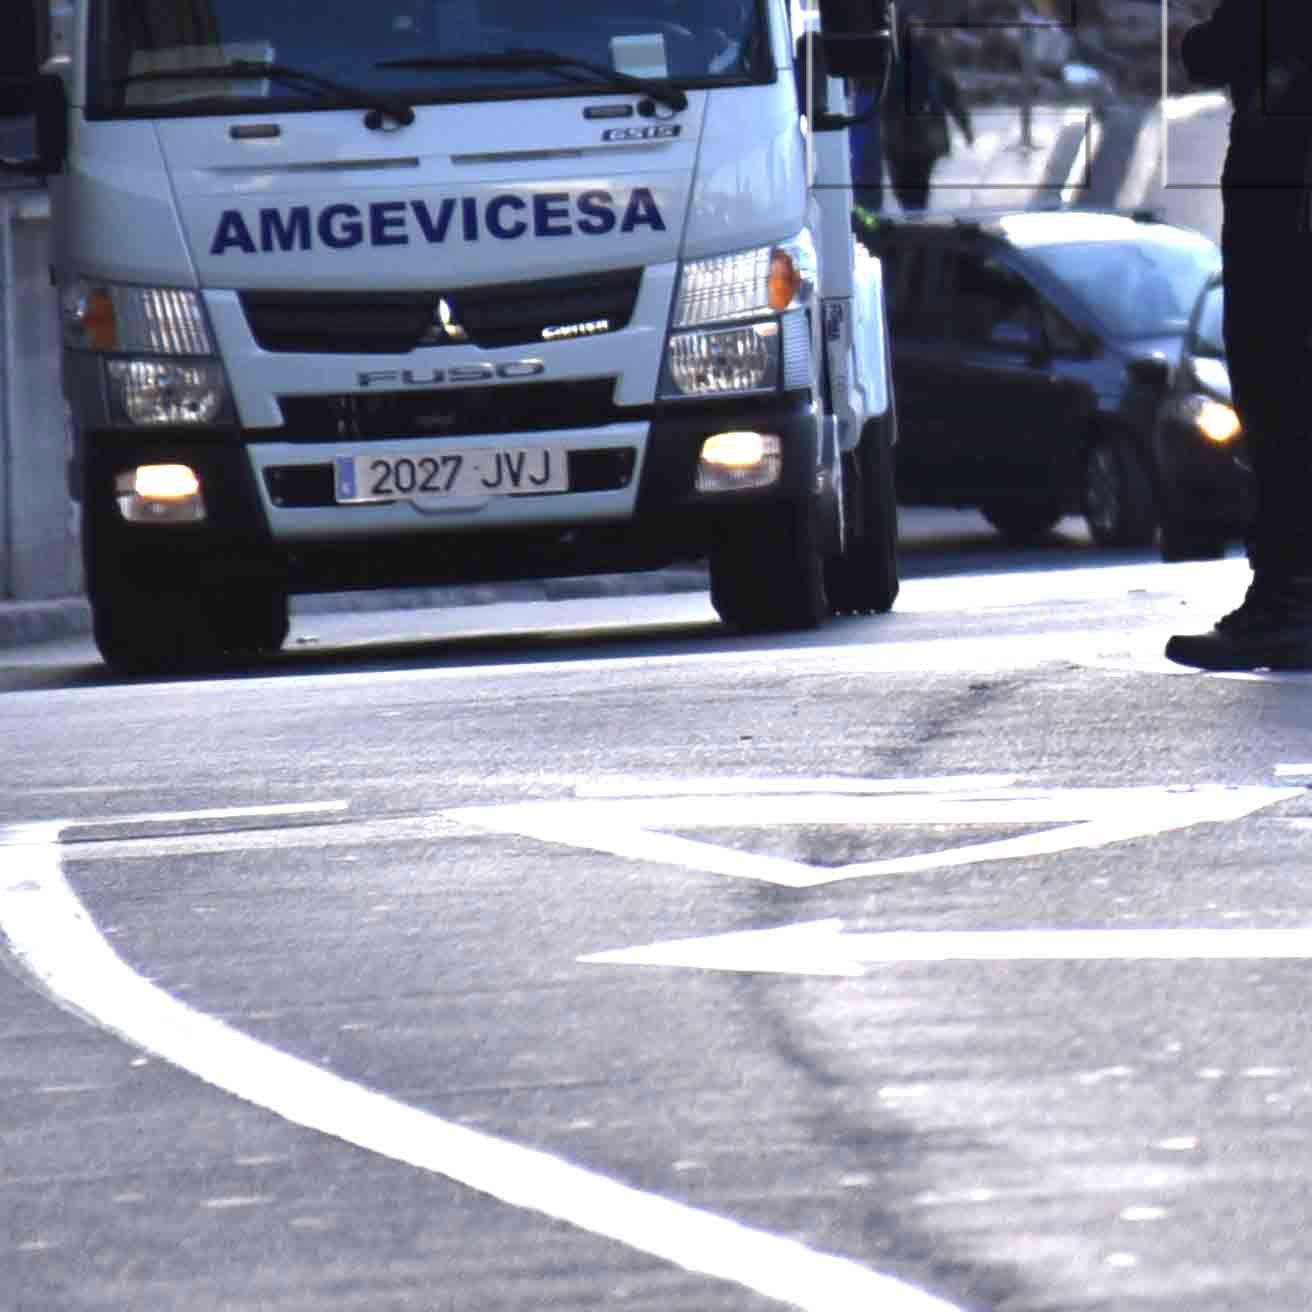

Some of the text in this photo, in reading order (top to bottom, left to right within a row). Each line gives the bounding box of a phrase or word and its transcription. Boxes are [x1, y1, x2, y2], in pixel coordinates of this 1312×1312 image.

[209, 186, 667, 256] AMGEVICESA
[355, 358, 546, 388] FUSO
[370, 449, 551, 496] 2027 JVJ
